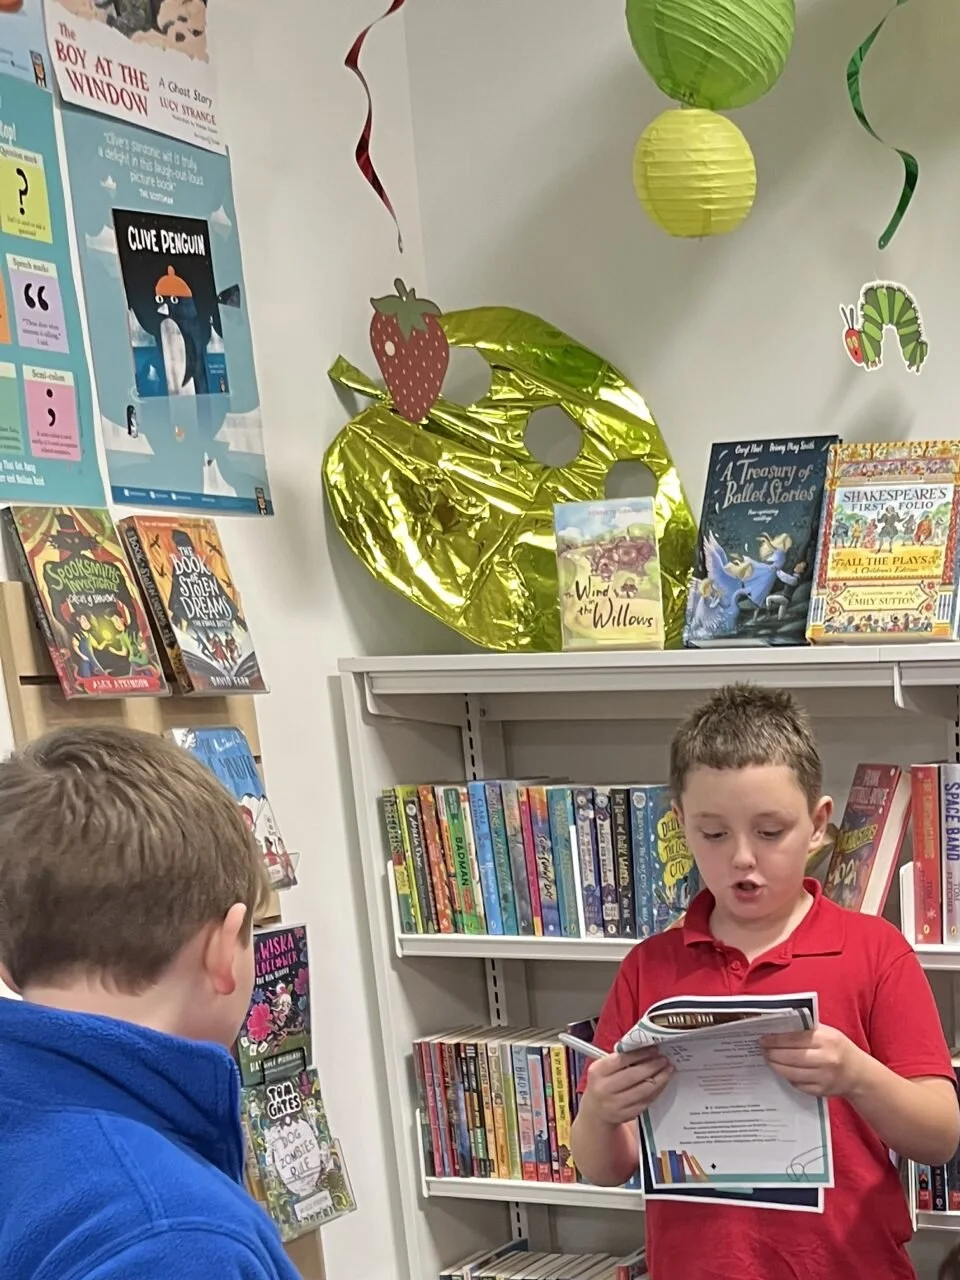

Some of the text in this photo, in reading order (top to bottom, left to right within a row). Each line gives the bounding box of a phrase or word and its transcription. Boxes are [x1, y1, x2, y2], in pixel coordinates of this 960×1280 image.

[58, 22, 76, 40] The
[55, 40, 150, 92] BOY AT THE
[65, 67, 148, 116] WINDOW
[158, 78, 212, 109] A Ghost Story
[160, 96, 179, 113] LUCY
[182, 104, 217, 126] STRANGE
[105, 148, 130, 167] delight
[162, 150, 173, 162] wit
[181, 155, 198, 172] truly
[128, 226, 206, 256] CLIVE PENGUIN
[12, 258, 50, 273] Speech marks
[32, 368, 66, 383] Semi-colon
[800, 440, 815, 450] Smith
[720, 458, 813, 486] A Treasury of
[722, 478, 816, 510] Ballet Stories
[843, 486, 948, 503] SHAKESPEARE'S
[851, 502, 934, 512] FIRST FOLIO
[178, 545, 194, 558] THE
[846, 556, 928, 567] ALL THE PLAYS
[44, 557, 120, 590] SPOOKSMITHS
[170, 553, 212, 576] BOOK
[894, 566, 919, 574] Edition
[62, 577, 120, 594] INVESTIGATE
[179, 575, 219, 598] STOLEN
[575, 575, 610, 602] Wind
[180, 596, 232, 620] DREAMS
[578, 598, 654, 629] the Willows
[878, 598, 916, 606] SUTTON
[92, 678, 150, 690] ALEX ATKINSON
[210, 676, 250, 688] DAVID FARR
[944, 782, 960, 861] SPACE BAND
[616, 835, 626, 854] DARK
[455, 837, 469, 886] BADMAN
[538, 856, 554, 900] SUNNY DAY
[260, 932, 295, 960] WISKA
[268, 1080, 294, 1102] TOM
[268, 1094, 301, 1120] GATES
[280, 1128, 302, 1149] DOG
[278, 1139, 316, 1170] ZOMBIES
